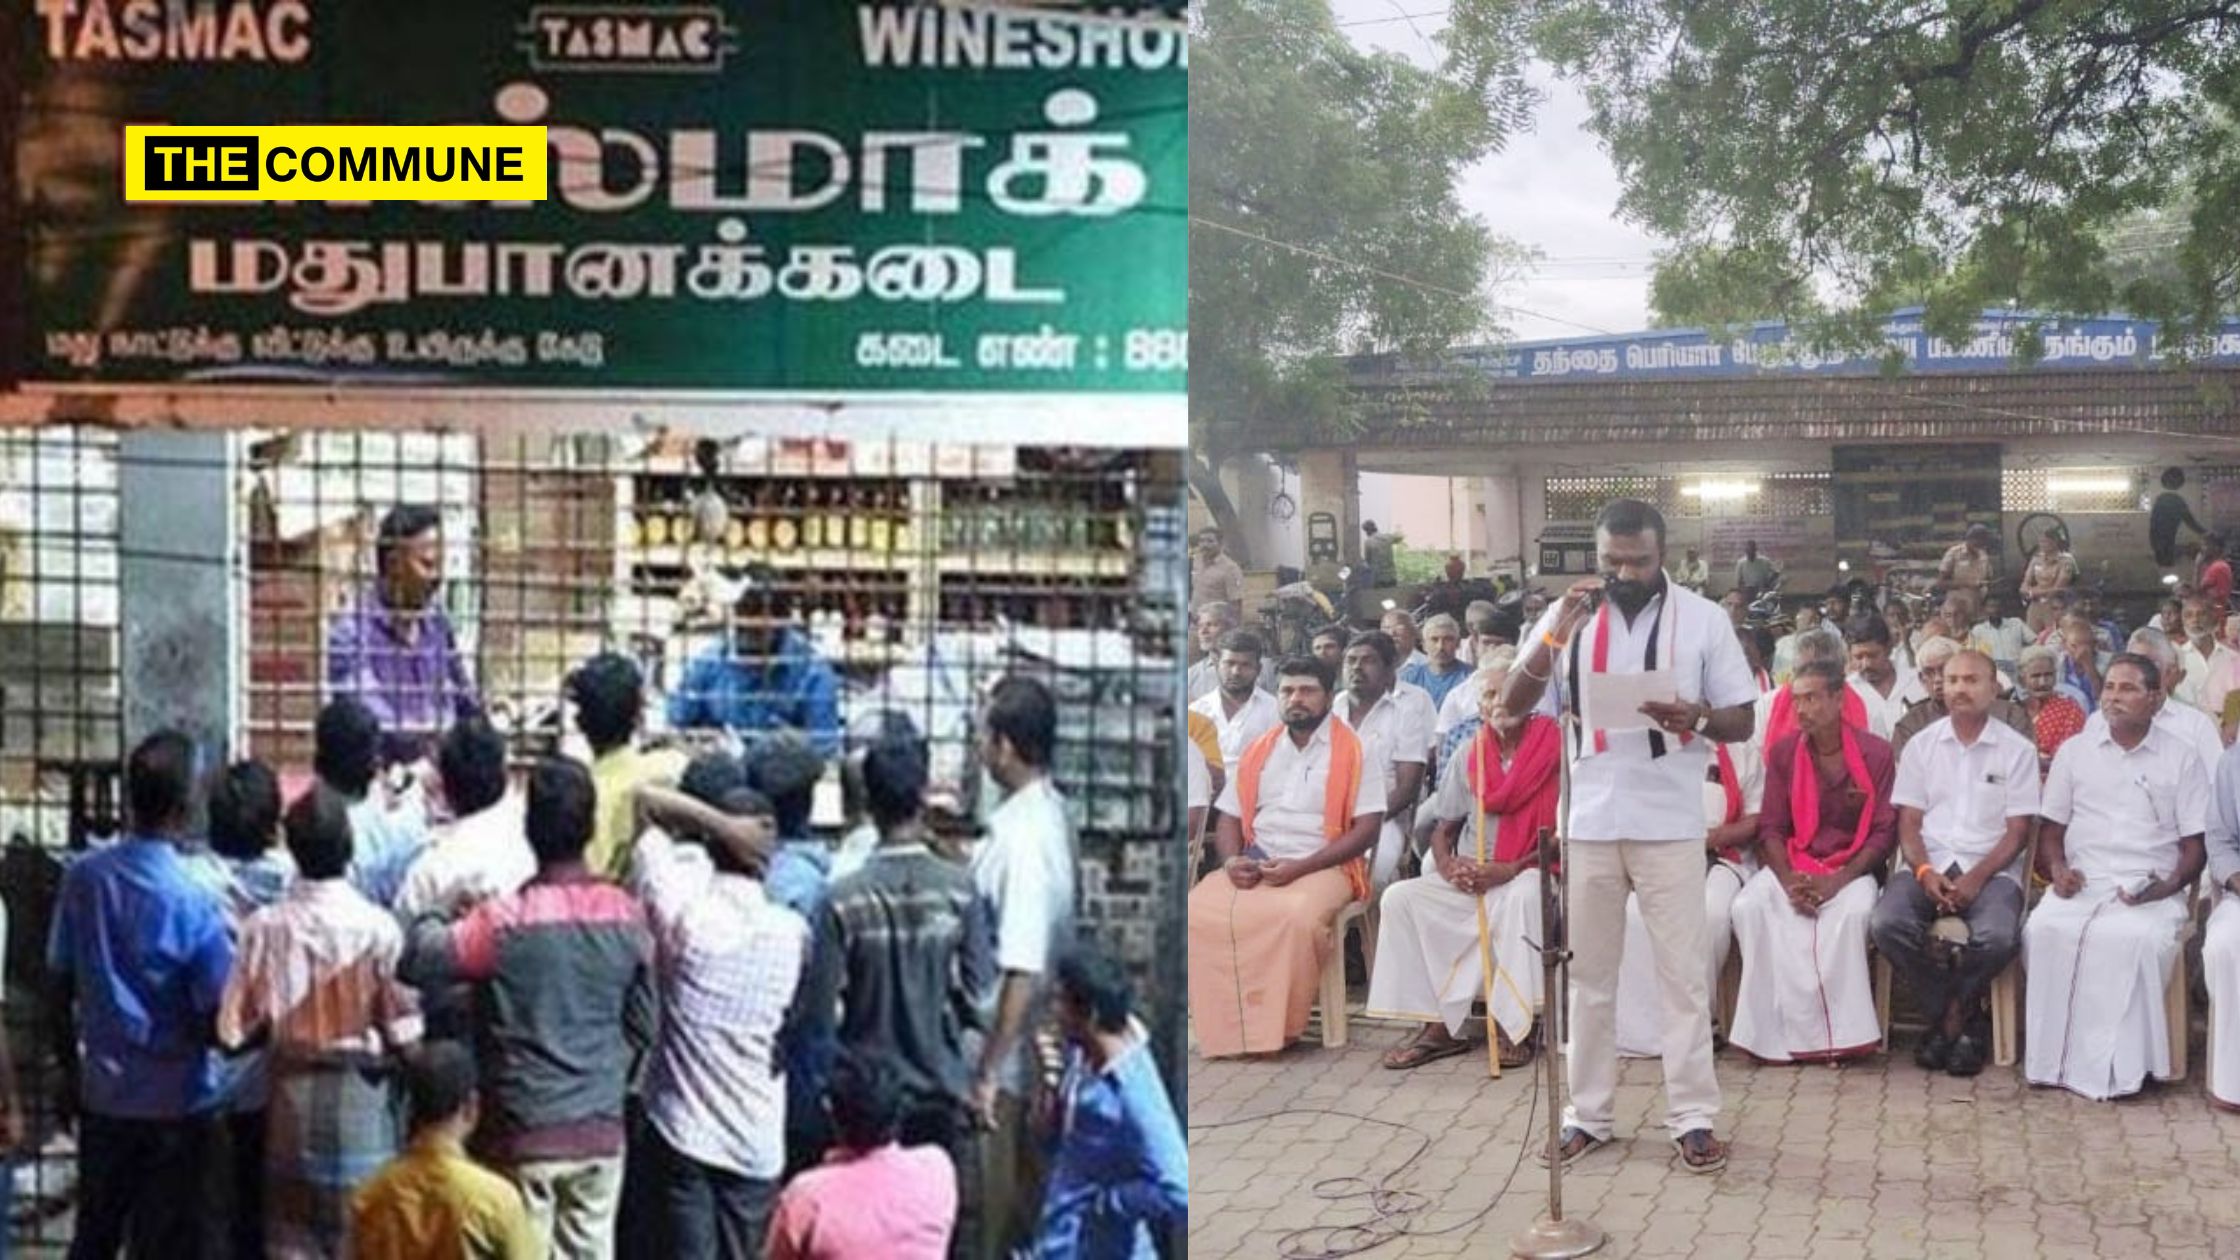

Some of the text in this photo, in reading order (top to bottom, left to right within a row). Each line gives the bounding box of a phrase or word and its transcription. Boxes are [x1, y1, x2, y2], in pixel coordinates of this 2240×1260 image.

[38, 0, 310, 60] TASMAC
[541, 17, 711, 59] TASMAC
[857, 5, 1188, 69] WINESHO
[190, 217, 1065, 314] மதுபானக்கடை
[856, 333, 962, 367] கடை
[978, 324, 1080, 370] எண்
[1531, 346, 1618, 377] தந்தை
[2043, 327, 2137, 361] தங்கும்
